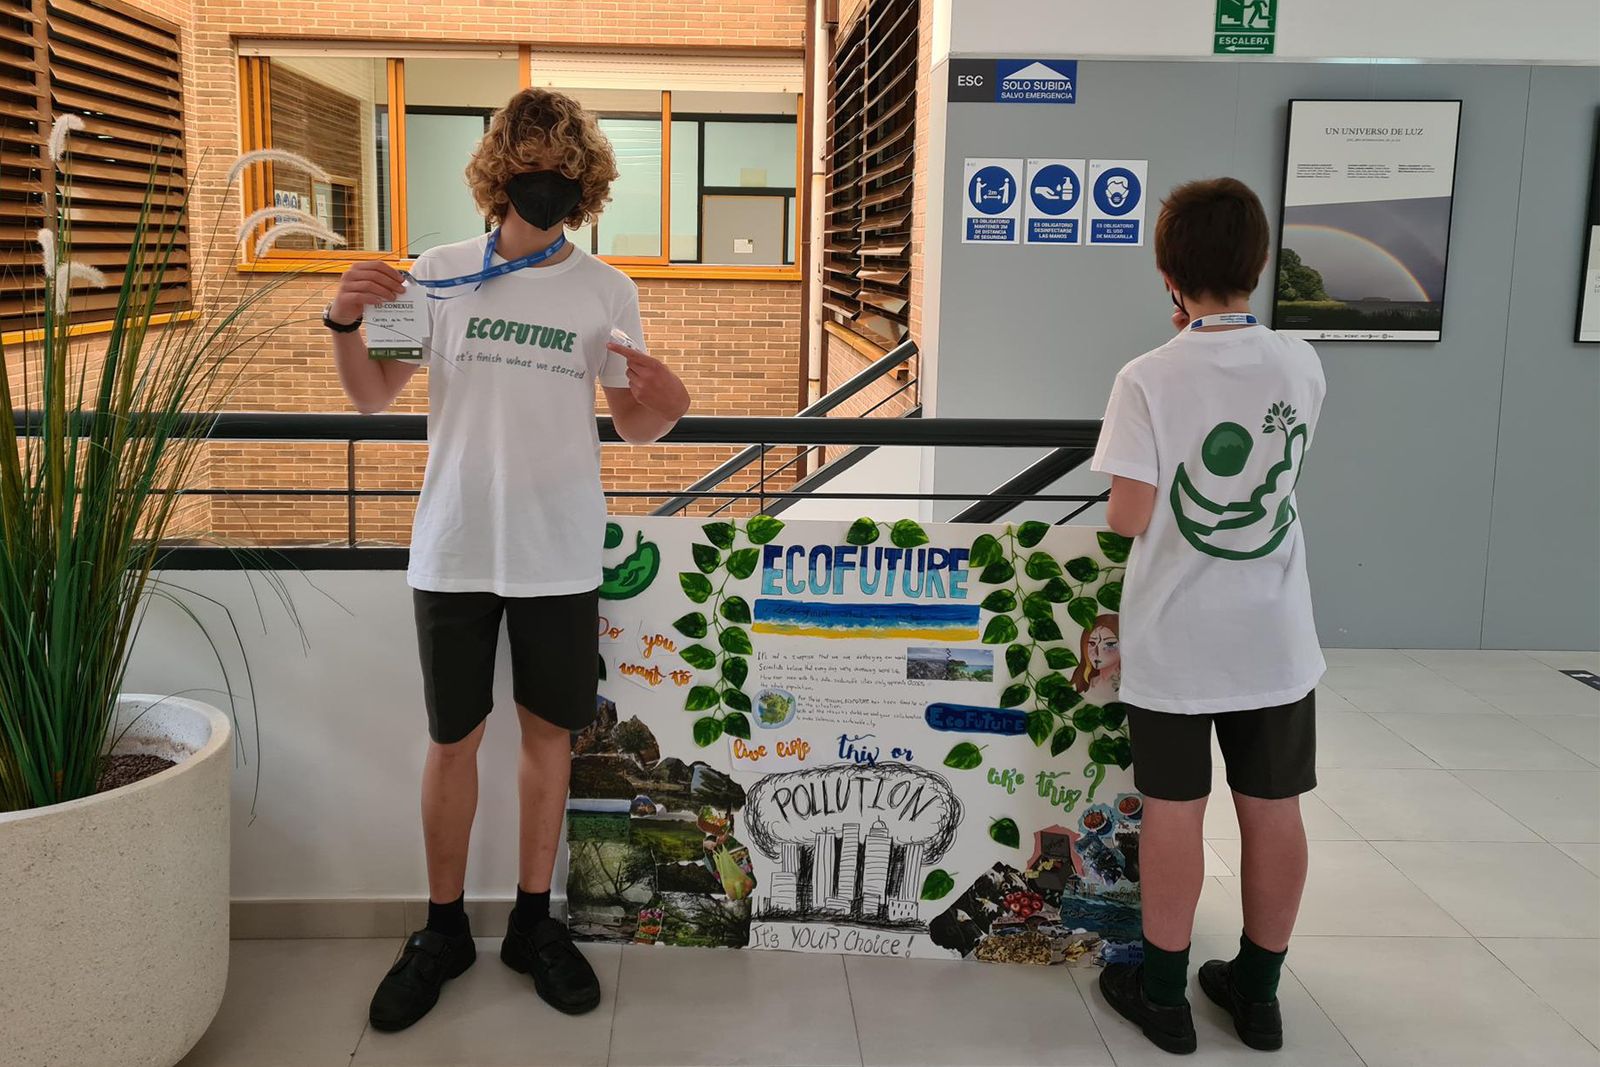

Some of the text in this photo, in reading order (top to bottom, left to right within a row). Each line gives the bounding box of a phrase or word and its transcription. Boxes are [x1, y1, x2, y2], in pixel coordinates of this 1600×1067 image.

[1219, 37, 1269, 45] ESCALERA
[957, 75, 984, 87] ESC
[1002, 81, 1072, 91] SOLO SUBIDA
[1405, 128, 1424, 136] LUZ
[465, 317, 577, 353] ECOFUTURE
[476, 352, 502, 363] finish
[506, 356, 532, 368] what
[536, 362, 548, 370] we
[551, 364, 586, 379] started
[761, 544, 970, 599] ECOFUTURE
[641, 633, 677, 659] you
[619, 662, 693, 687] want to
[733, 733, 914, 768] live life this or
[987, 767, 1025, 794] like
[771, 777, 938, 824] POLLUTION
[751, 924, 780, 949] It's
[792, 926, 840, 950] YOUR
